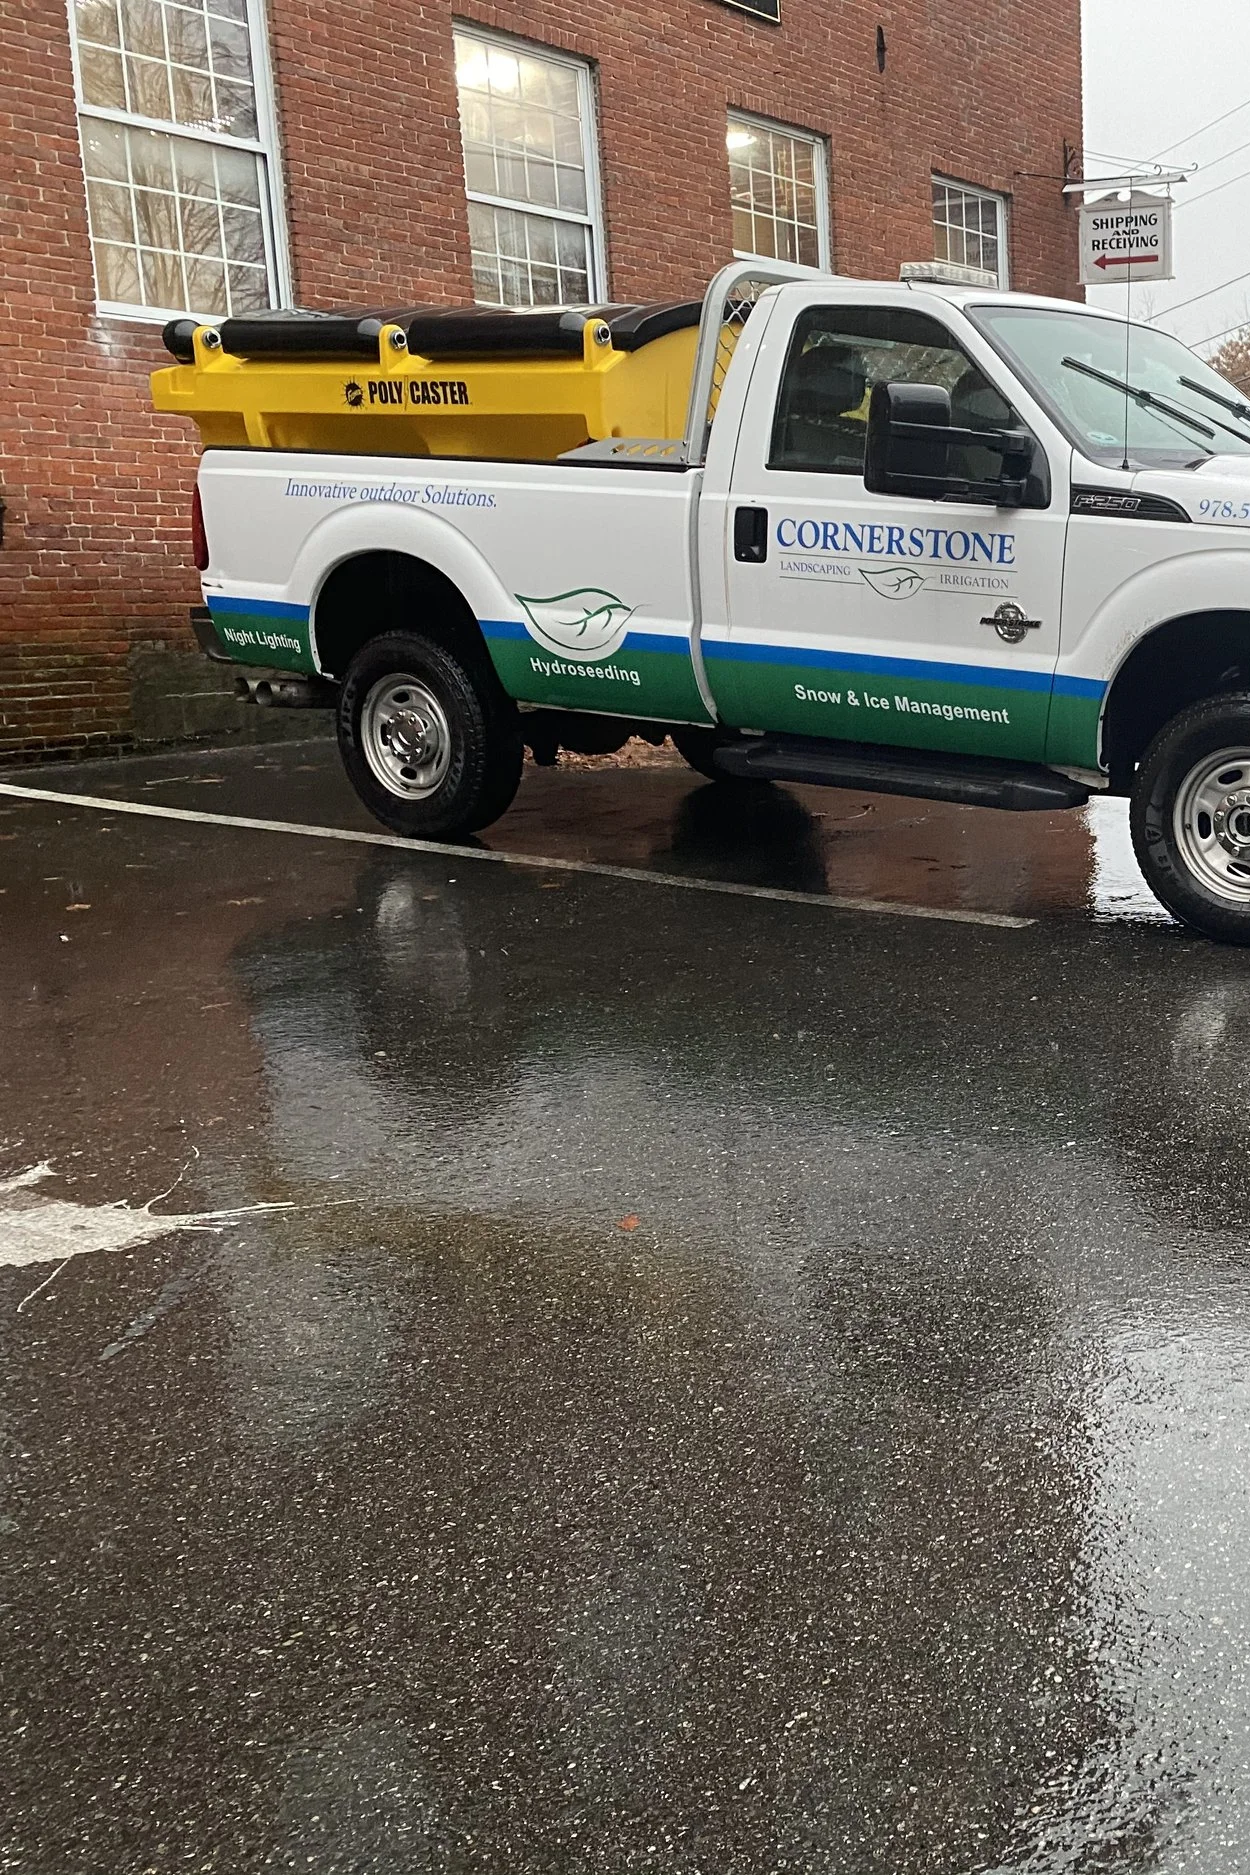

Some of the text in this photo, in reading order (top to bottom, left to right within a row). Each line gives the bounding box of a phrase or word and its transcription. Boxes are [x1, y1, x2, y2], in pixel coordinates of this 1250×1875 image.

[1092, 213, 1158, 230] SHIPPING
[1112, 228, 1140, 236] AND
[1092, 235, 1159, 251] RECEIVING
[367, 381, 403, 404] POLY
[409, 381, 469, 405] CASTER
[285, 478, 497, 508] Innovative outdoor Solutions.
[776, 518, 1016, 565] CORNERSTONE
[780, 560, 851, 576] LANDSCAPING
[940, 573, 1009, 589] IRRIGATION
[223, 627, 302, 654] Night Lighting
[530, 657, 641, 686] Hydroseeding
[794, 684, 1010, 724] Snow & Ice Management
